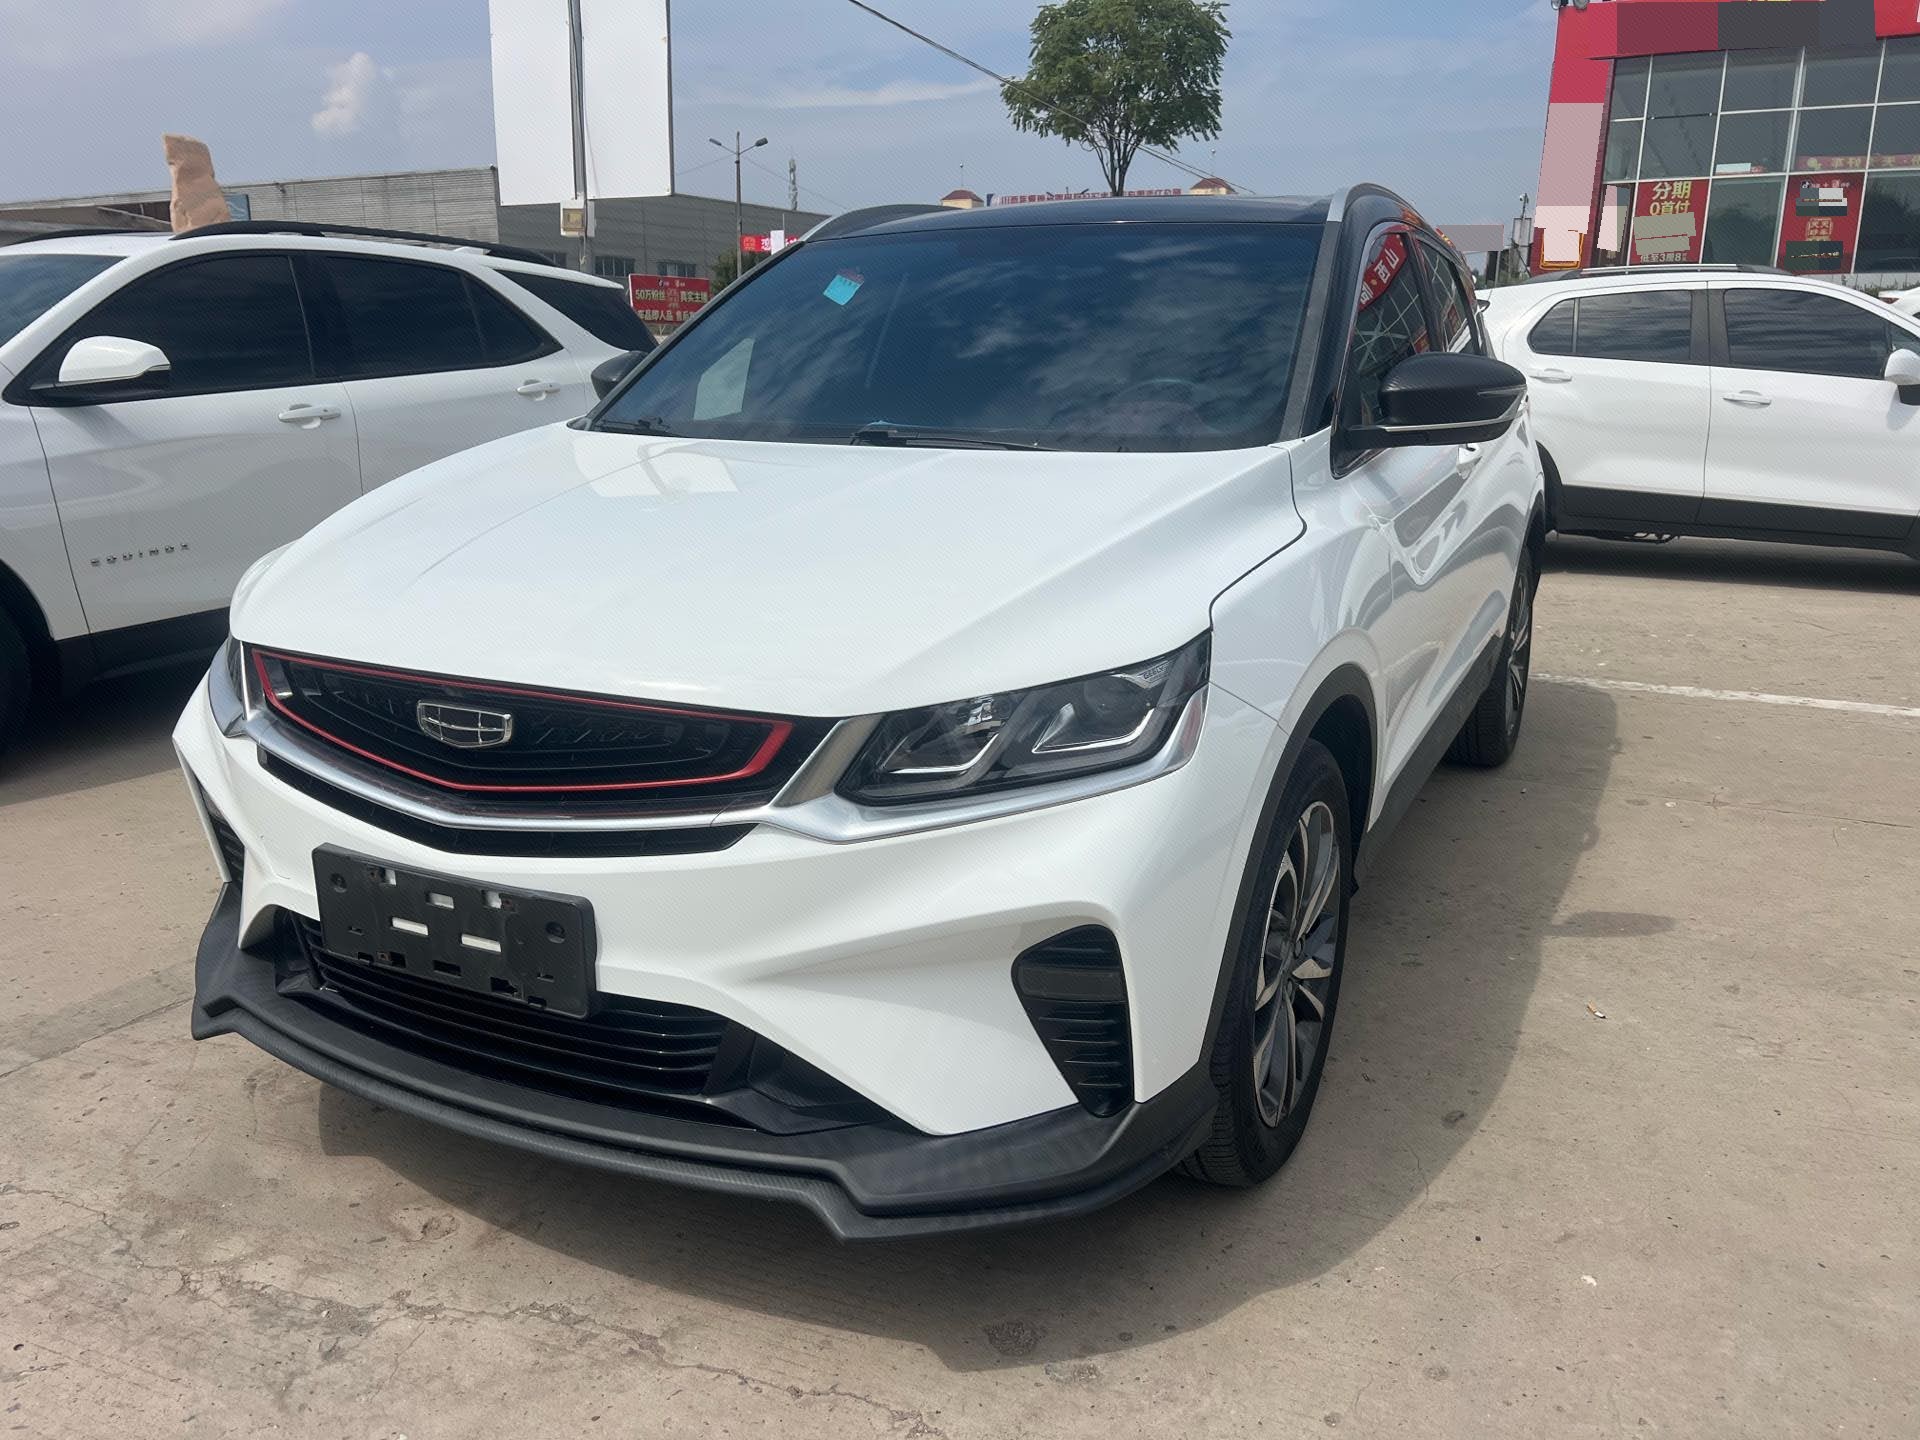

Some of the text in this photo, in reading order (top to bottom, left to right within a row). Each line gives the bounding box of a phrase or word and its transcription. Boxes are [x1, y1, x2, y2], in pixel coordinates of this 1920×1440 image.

[1652, 181, 1691, 200] 分期
[1650, 200, 1691, 216] 0首付
[635, 289, 666, 301] 50万粉丝
